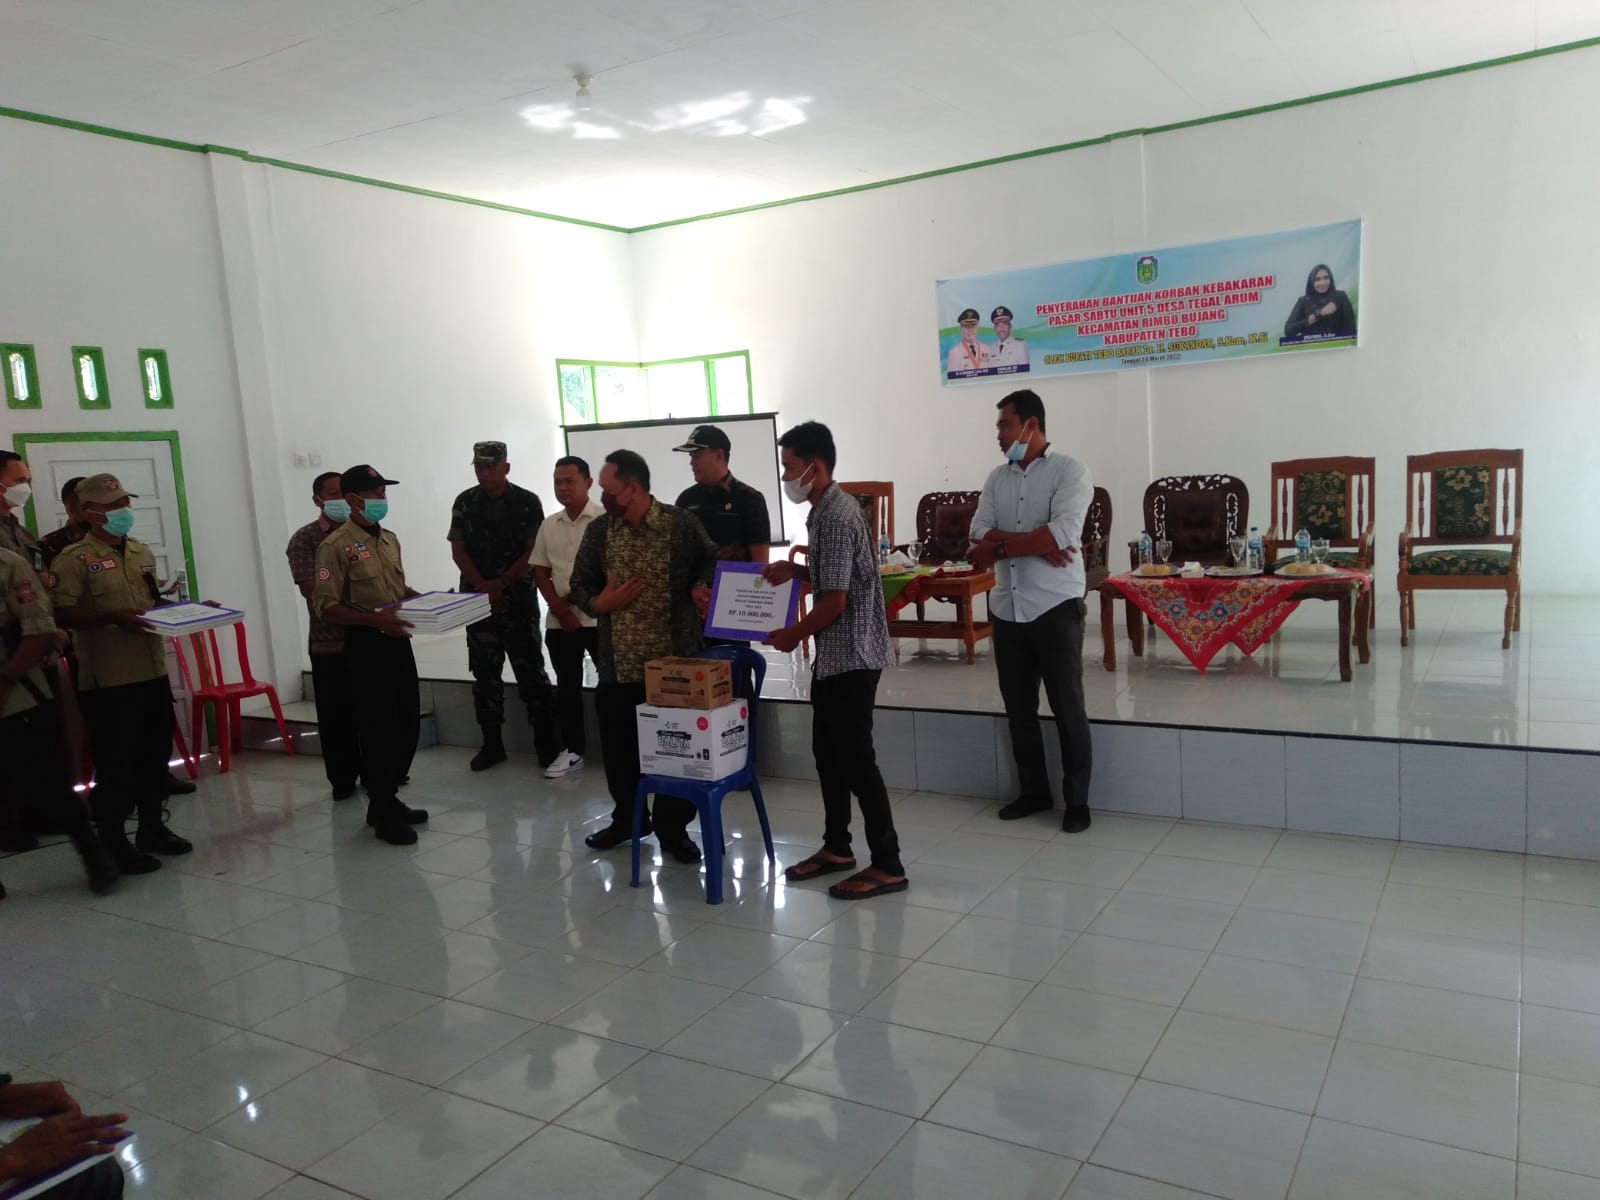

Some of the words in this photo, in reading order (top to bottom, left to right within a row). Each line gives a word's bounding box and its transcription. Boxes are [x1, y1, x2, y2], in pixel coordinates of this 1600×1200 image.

[1035, 298, 1100, 316] PENYERAHAN
[1102, 291, 1152, 307] BANTUAN
[1154, 285, 1200, 301] KORBAN
[1202, 275, 1273, 295] KEBAKARAN
[1048, 315, 1081, 327] PASAR
[1083, 309, 1117, 323] SABTU
[1120, 305, 1145, 318] UNIT
[1147, 304, 1154, 315] 5
[1157, 300, 1185, 314] DESA
[1188, 296, 1222, 310] TEGAL
[1224, 291, 1259, 306] ARUM
[1077, 319, 1139, 336] KECAMATAN
[1142, 315, 1179, 328] RIMBO
[1181, 309, 1226, 324] BUJANG
[1104, 329, 1166, 345] KABUPATEN
[1168, 325, 1196, 339] TEBO
